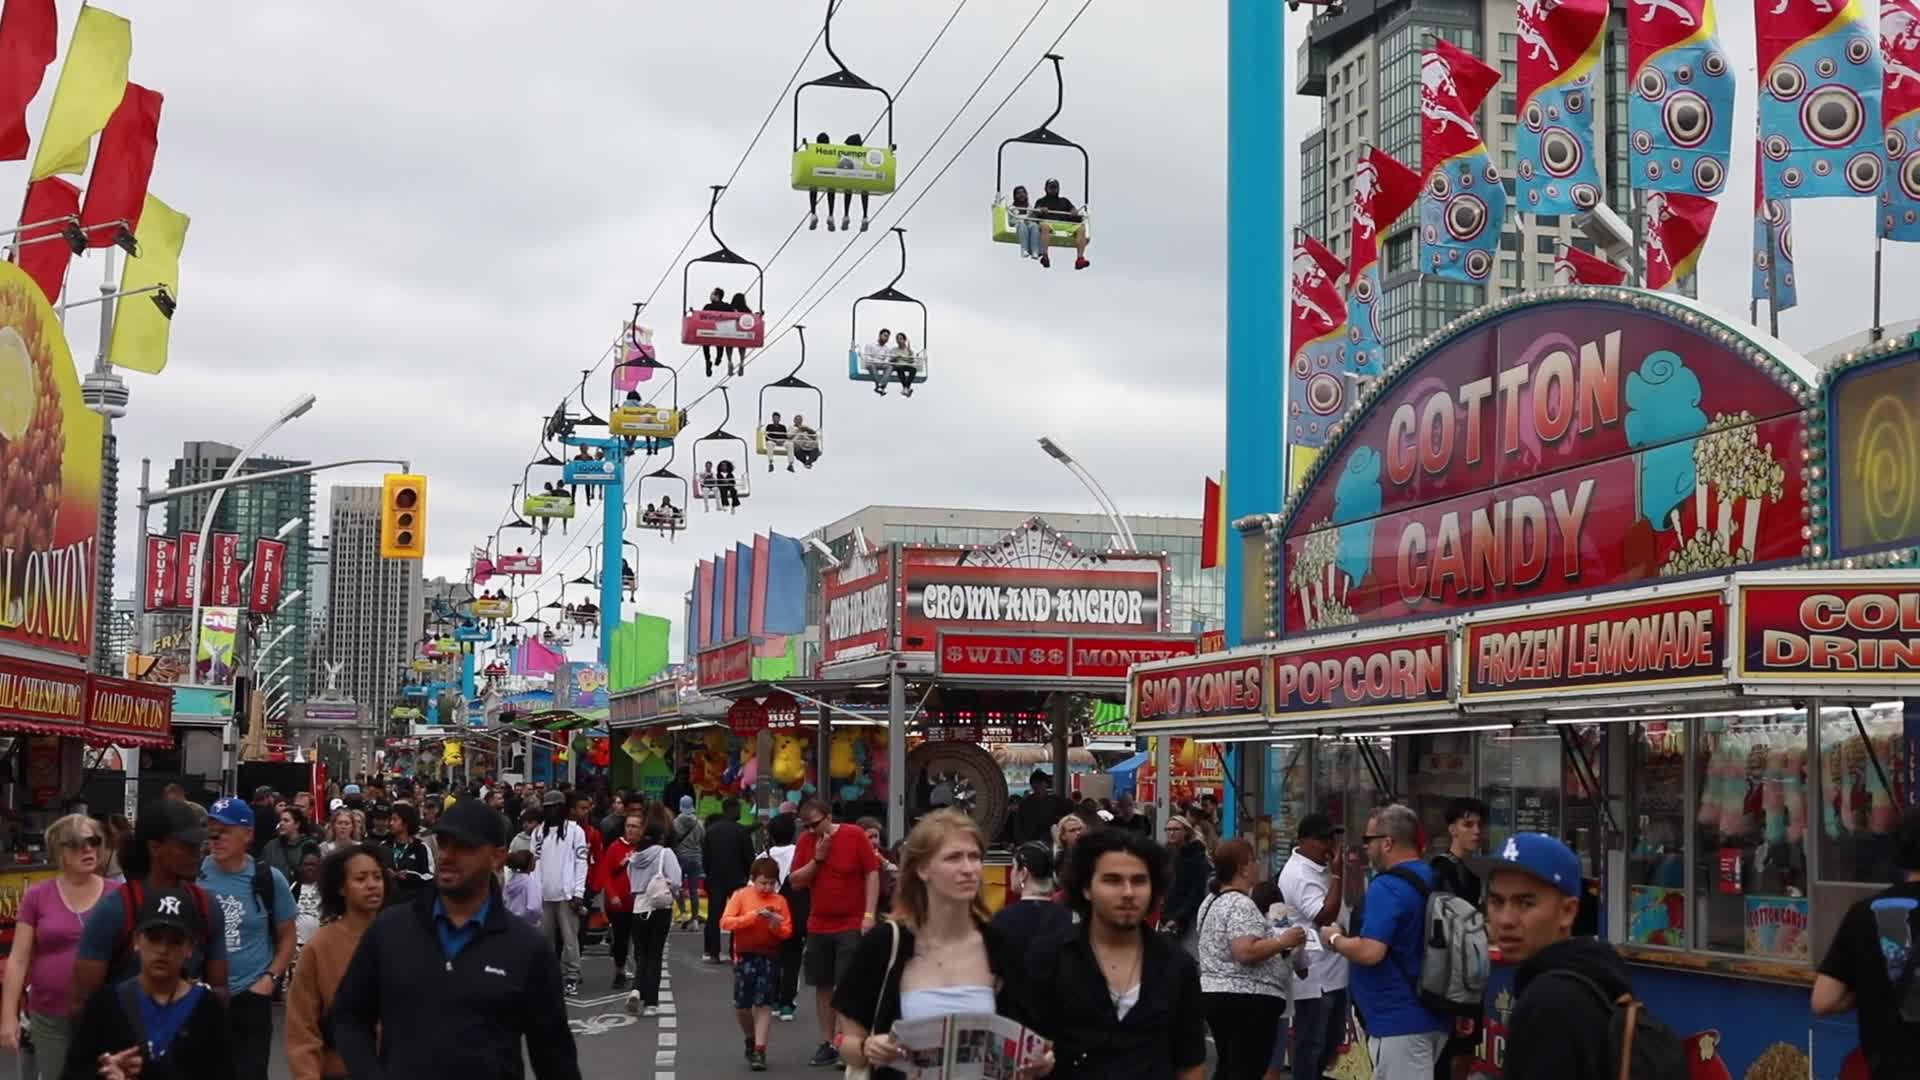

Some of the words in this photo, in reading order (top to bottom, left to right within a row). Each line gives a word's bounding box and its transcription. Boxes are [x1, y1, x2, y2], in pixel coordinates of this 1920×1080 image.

[1387, 330, 1622, 485] COTTON
[1397, 479, 1595, 604] CANDY
[24, 536, 93, 647] ONION
[259, 548, 275, 605] FRIES
[923, 584, 1001, 620] CROWN
[1005, 585, 1050, 622] AND
[1056, 587, 1143, 625] ANCHOR
[152, 631, 183, 653] FRY
[965, 646, 1026, 665] WIN
[1477, 625, 1564, 687] FROZEN
[1568, 609, 1713, 679] LEMONADE
[1142, 677, 1181, 719] SNO
[1186, 666, 1260, 712] KONES
[1280, 646, 1442, 707] POPCORN
[91, 690, 133, 724] LOADED
[768, 714, 795, 722] BIG
